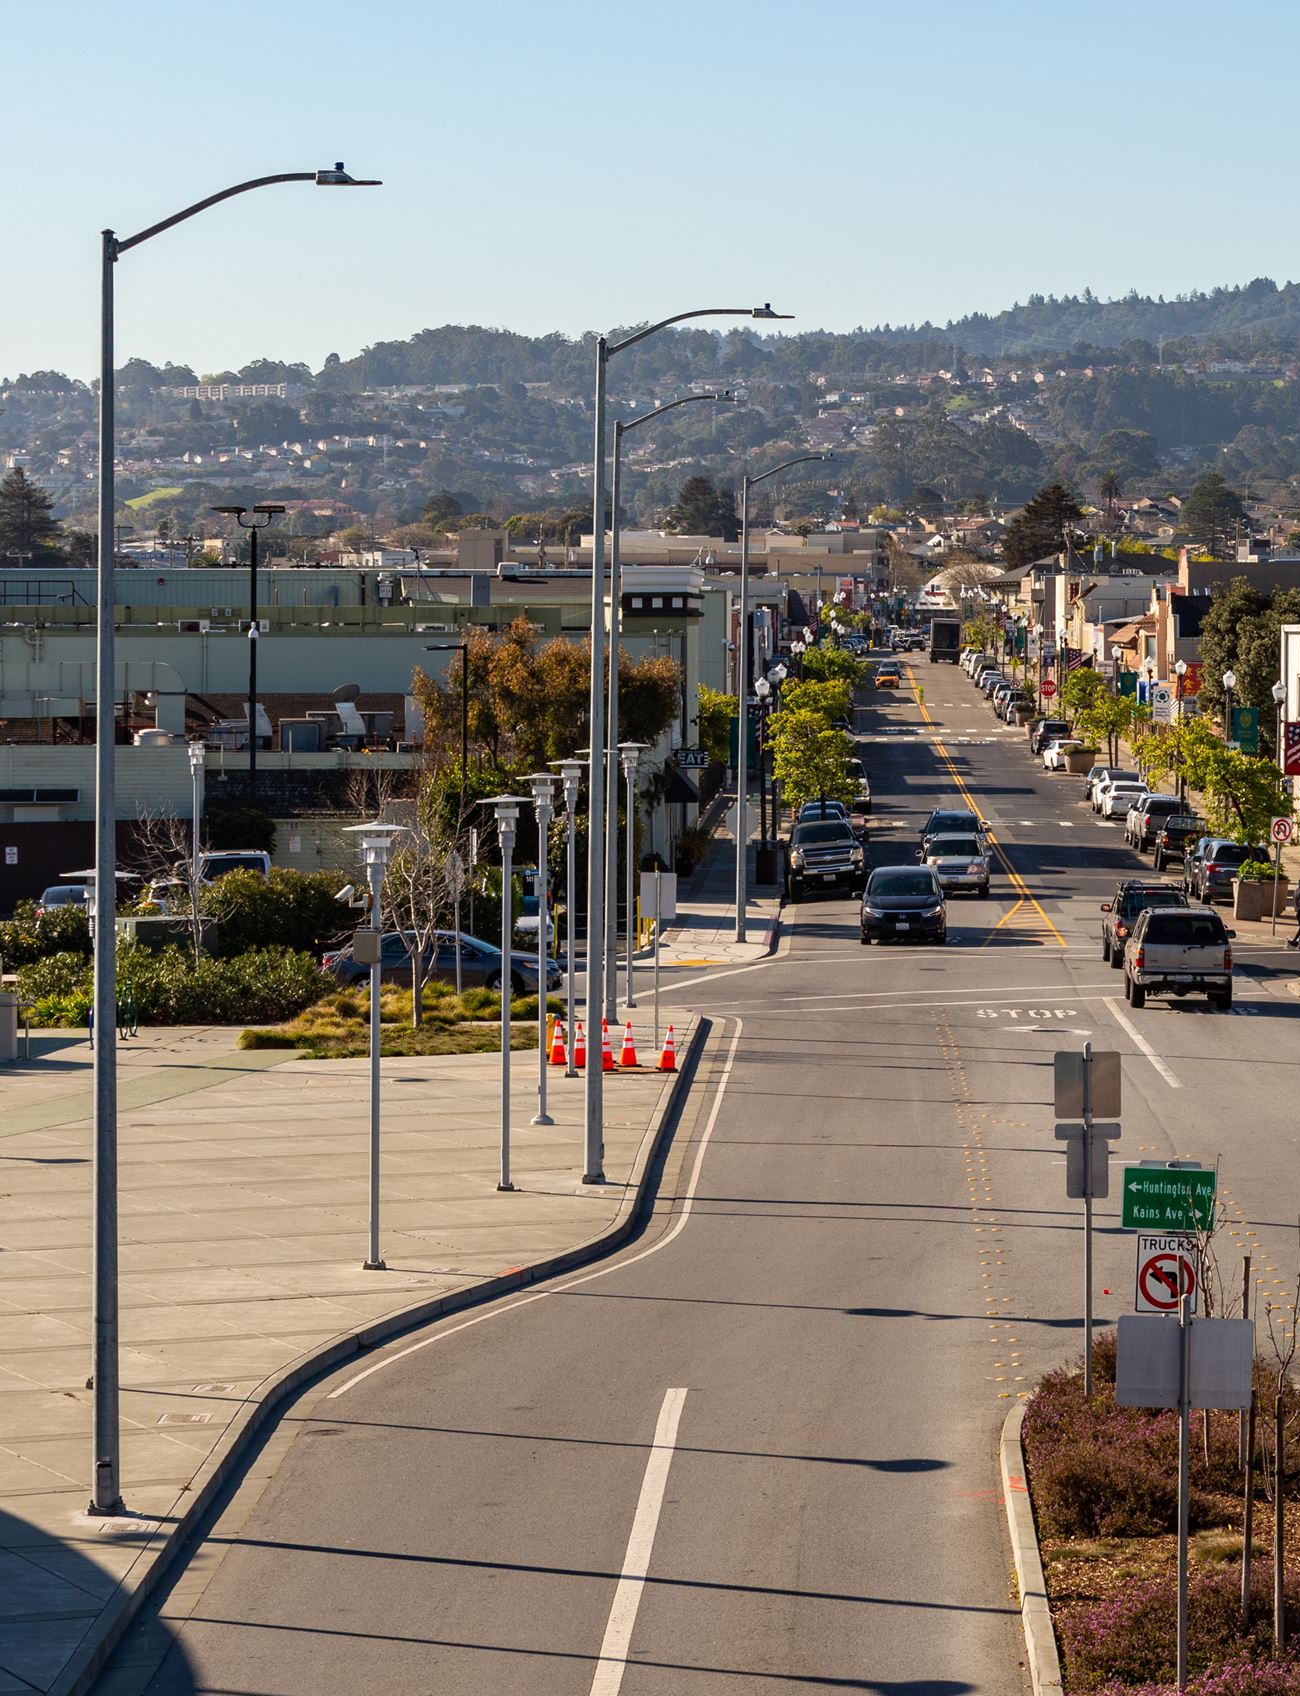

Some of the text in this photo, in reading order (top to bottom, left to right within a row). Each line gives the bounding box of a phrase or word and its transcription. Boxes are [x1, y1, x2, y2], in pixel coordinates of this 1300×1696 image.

[1041, 684, 1056, 692] STOP
[678, 752, 703, 764] EAT
[975, 1008, 1078, 1019] STOP
[1143, 1180, 1212, 1198] Huntington Ave
[1132, 1205, 1183, 1219] Kains Ave
[1141, 1238, 1194, 1251] TRUCKS
